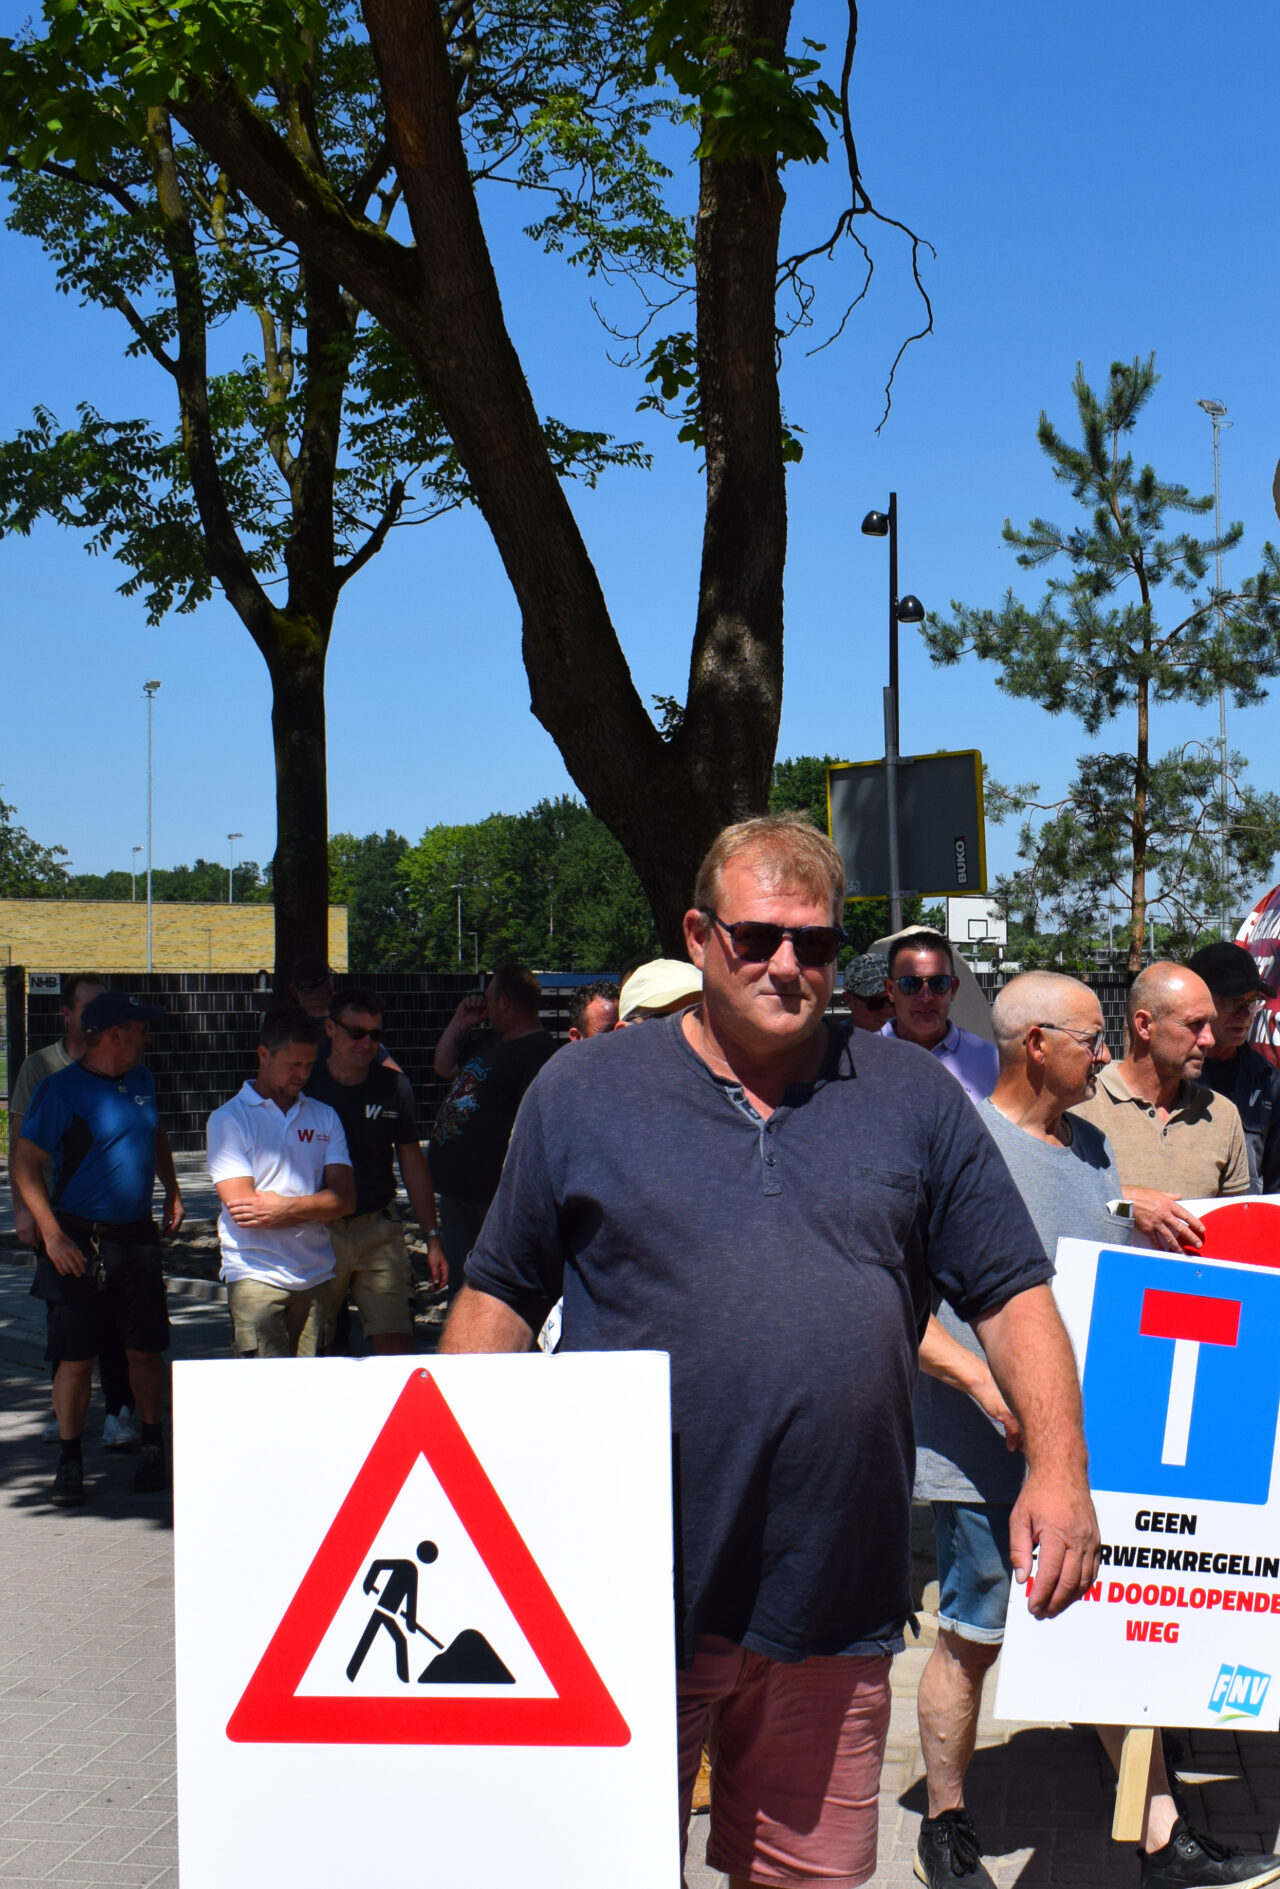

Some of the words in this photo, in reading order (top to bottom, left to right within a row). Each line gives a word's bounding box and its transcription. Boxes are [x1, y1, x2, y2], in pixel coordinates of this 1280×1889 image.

[956, 840, 967, 884] BUKO
[297, 1129, 315, 1143] W
[1134, 1510, 1198, 1536] GEEN
[1125, 1619, 1180, 1644] WEG
[1211, 1673, 1271, 1706] FNV
